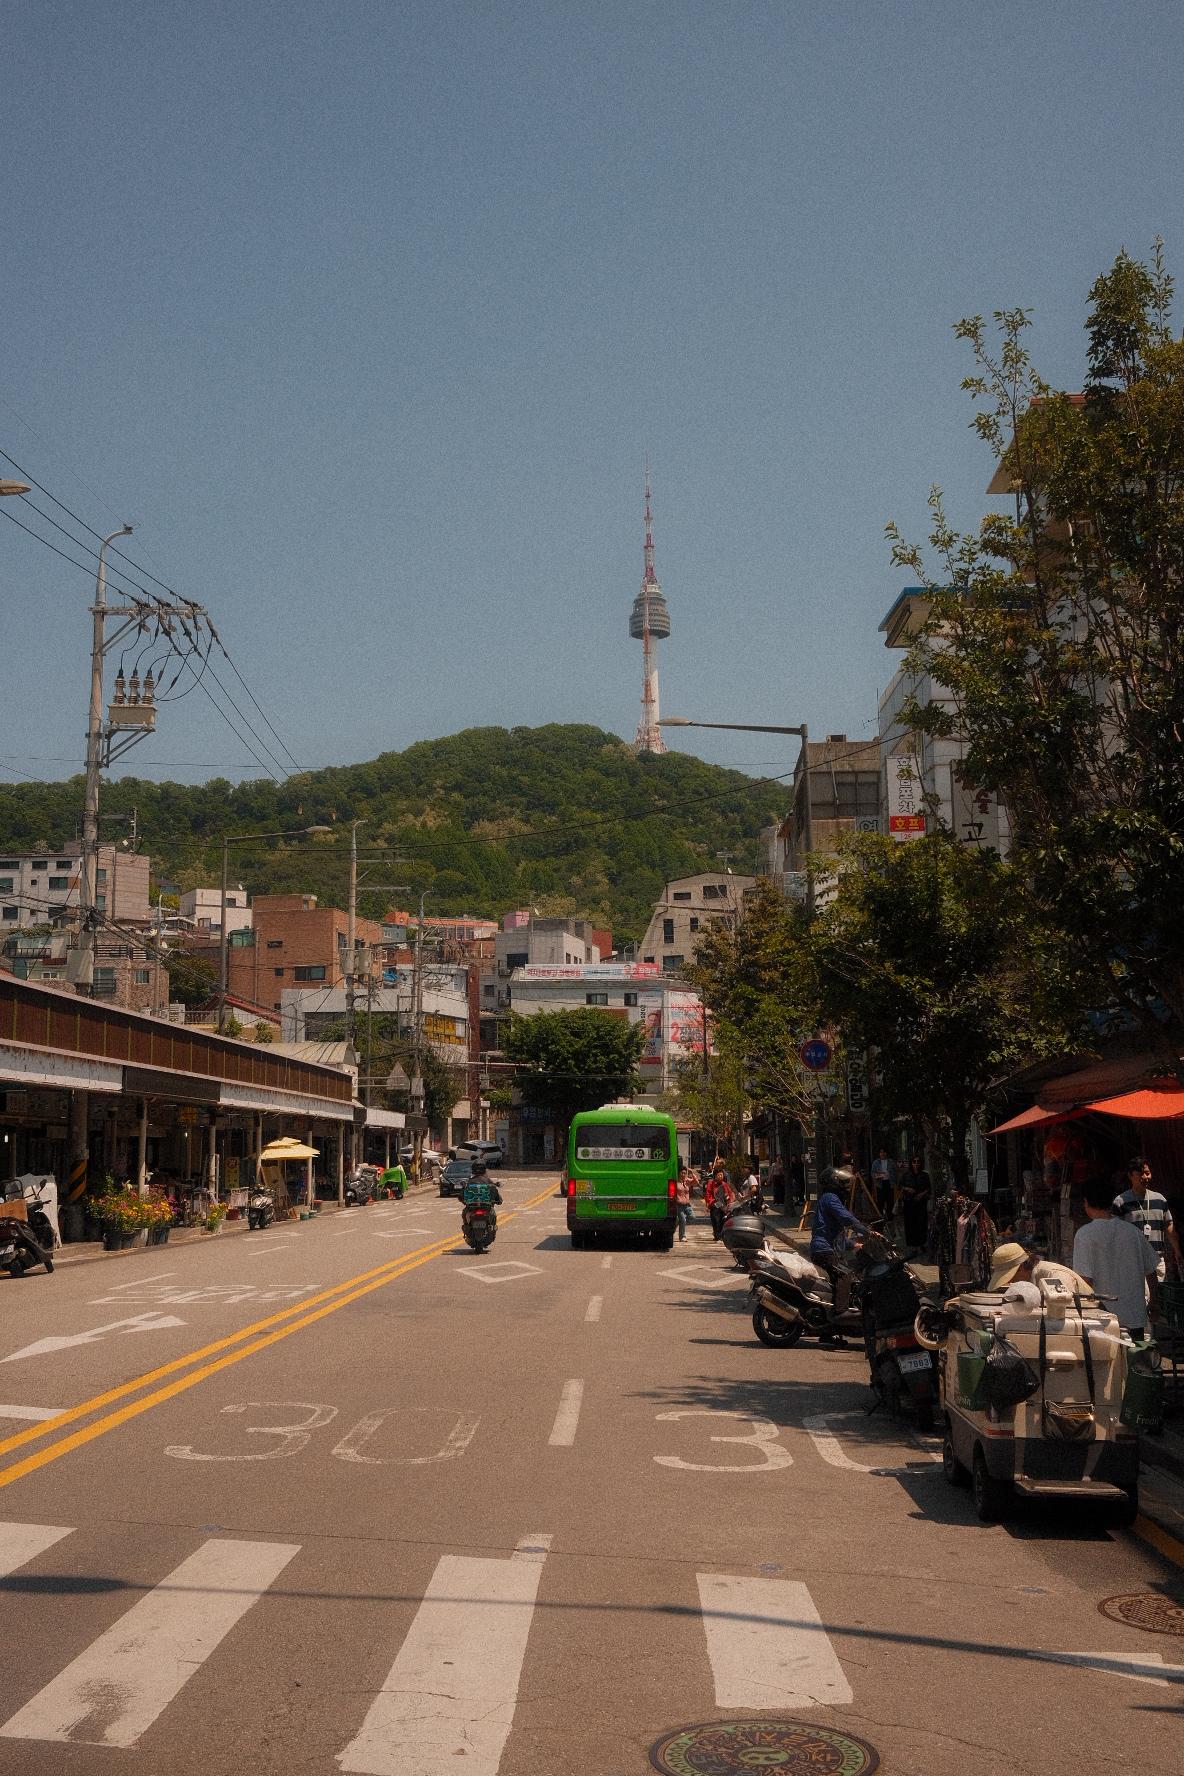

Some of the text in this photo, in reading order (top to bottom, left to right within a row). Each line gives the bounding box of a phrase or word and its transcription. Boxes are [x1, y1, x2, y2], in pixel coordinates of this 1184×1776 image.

[895, 818, 920, 831] 호프
[653, 1151, 664, 1159] 02
[163, 1401, 481, 1465] 30
[653, 1410, 945, 1476] 30
